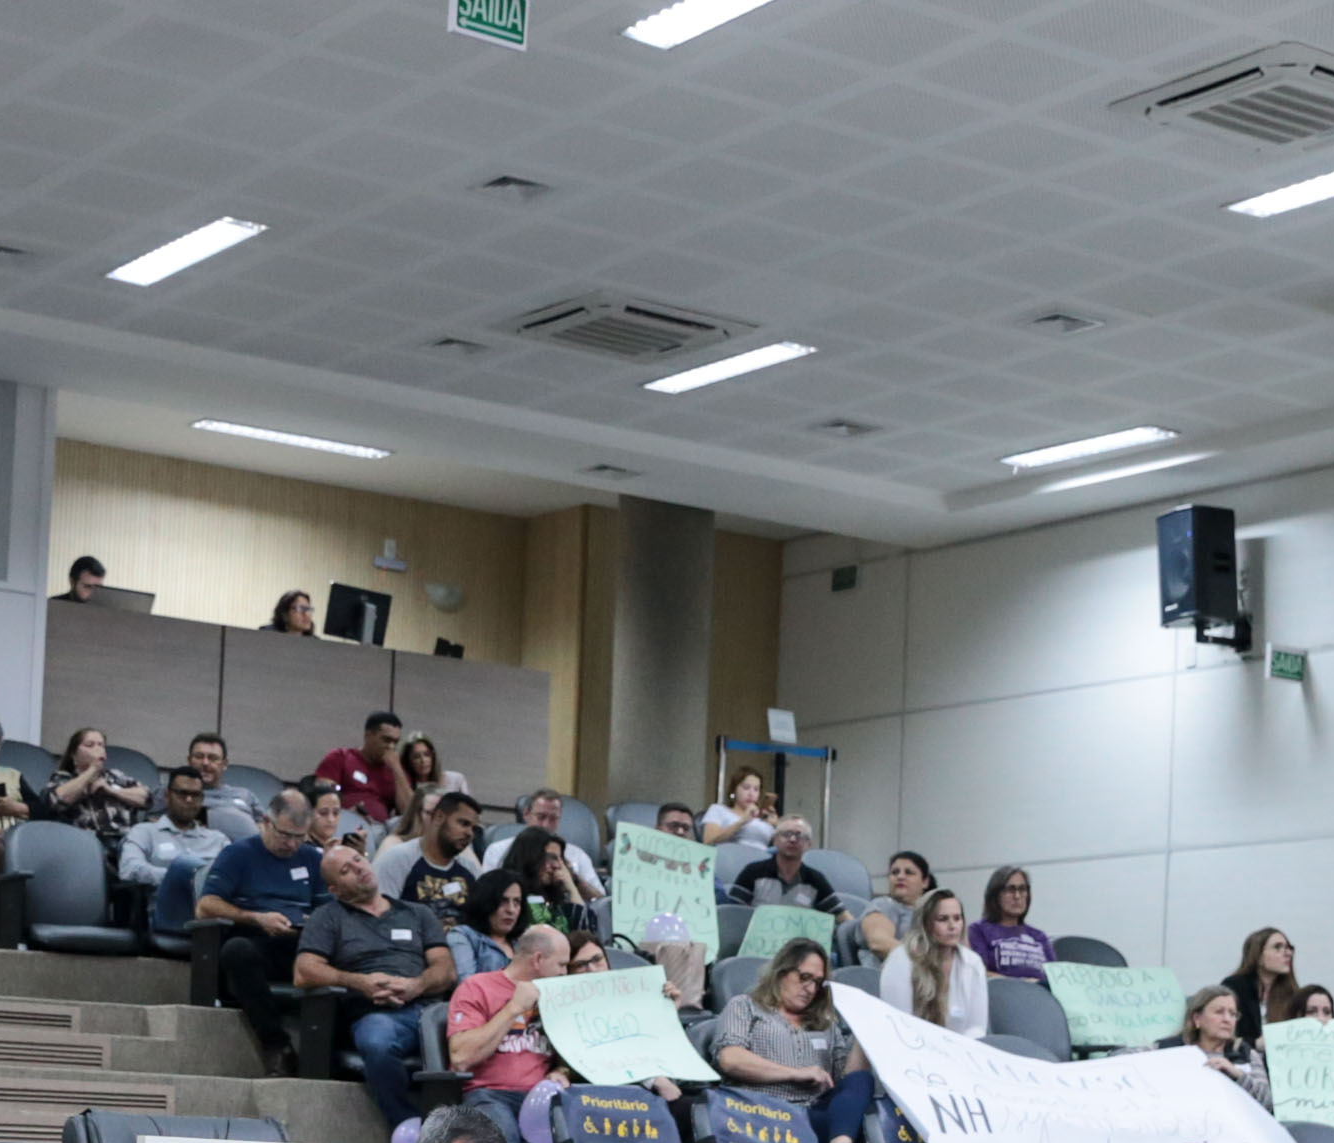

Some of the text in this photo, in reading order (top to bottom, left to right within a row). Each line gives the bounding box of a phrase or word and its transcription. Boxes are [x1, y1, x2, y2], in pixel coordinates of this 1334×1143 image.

[581, 1095, 649, 1112] Prioritário
[725, 1097, 792, 1122] Prioritário
[929, 1092, 993, 1134] NH
